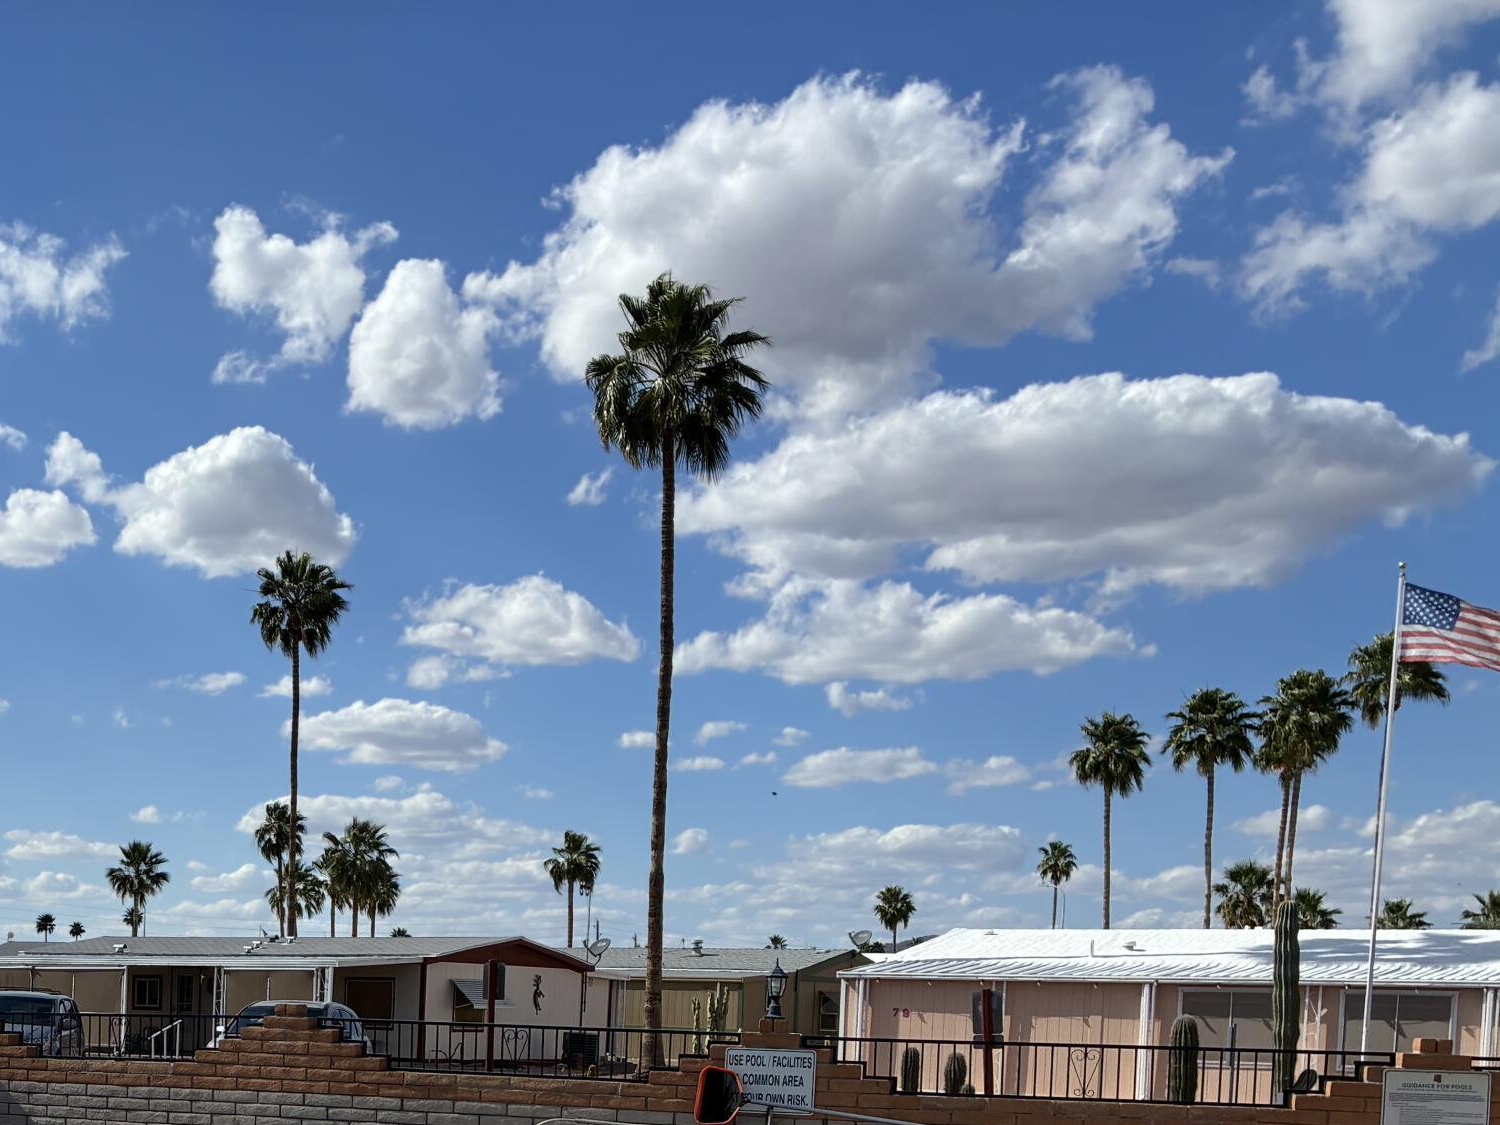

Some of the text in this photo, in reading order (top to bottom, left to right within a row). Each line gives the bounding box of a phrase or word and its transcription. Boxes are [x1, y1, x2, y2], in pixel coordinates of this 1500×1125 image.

[728, 1054, 744, 1066] USE
[745, 1055, 766, 1067] POOL
[772, 1056, 813, 1069] FACILITIES
[742, 1073, 804, 1087] COMMON AREA
[765, 1093, 785, 1105] OWN
[787, 1094, 808, 1106] RISK.
